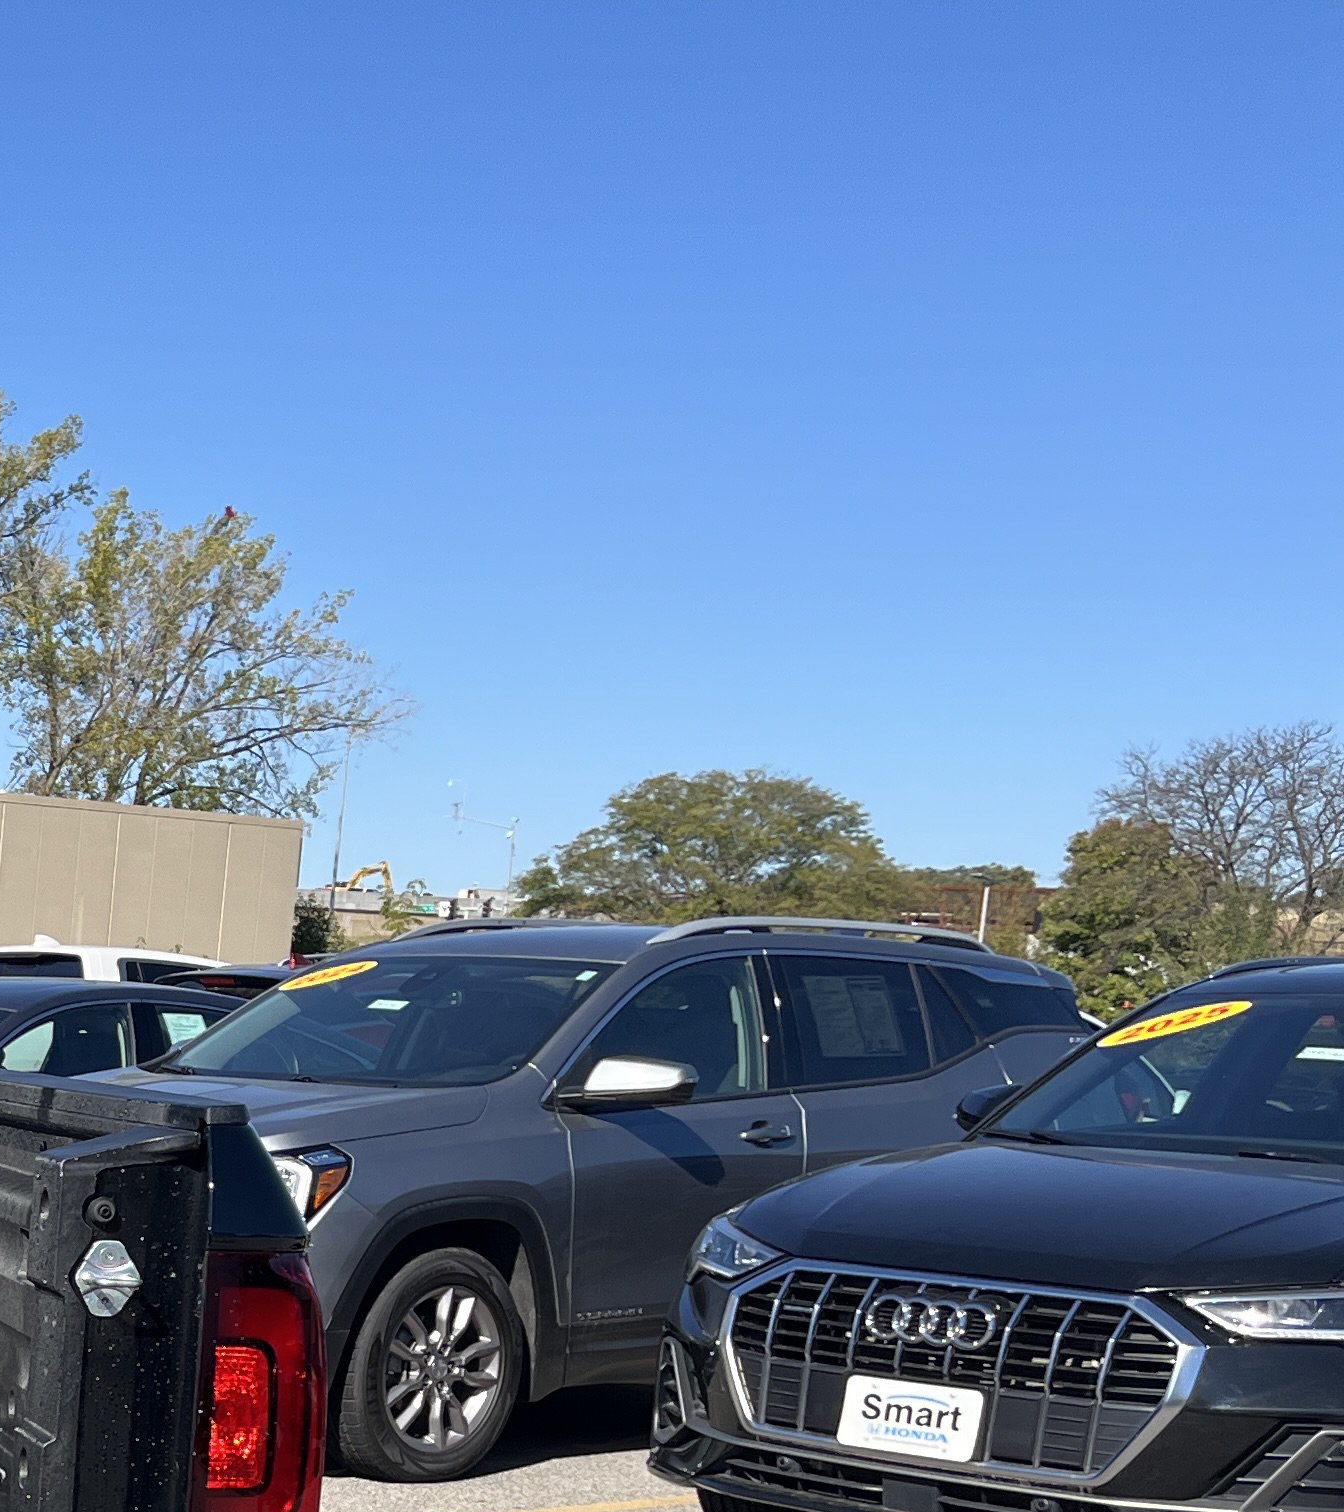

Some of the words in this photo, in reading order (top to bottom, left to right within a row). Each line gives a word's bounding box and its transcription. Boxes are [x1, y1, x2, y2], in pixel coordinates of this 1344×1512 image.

[1118, 1004, 1232, 1041] 2025
[862, 1393, 962, 1431] Smart
[884, 1426, 949, 1443] HONDA
